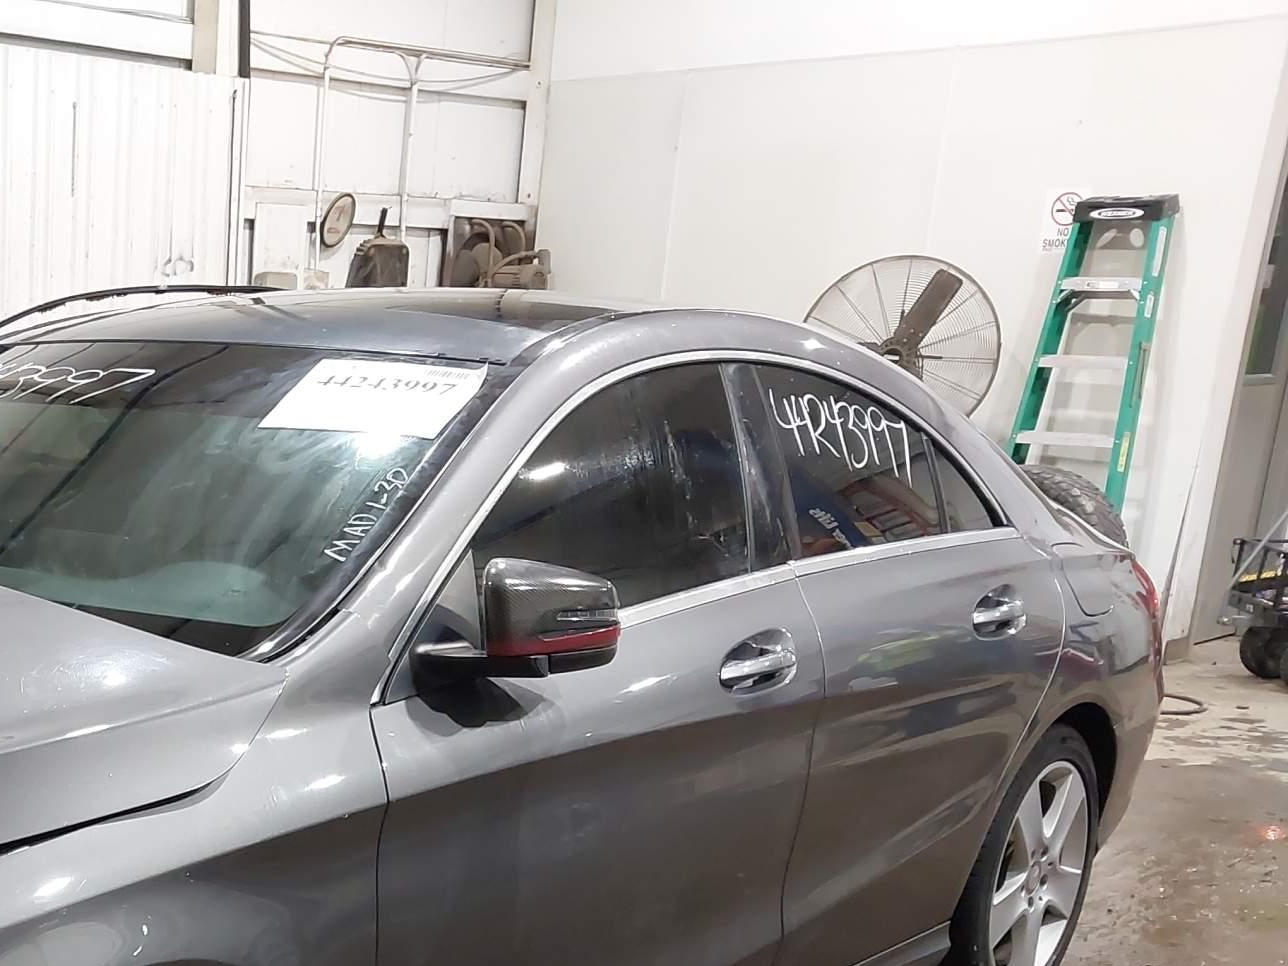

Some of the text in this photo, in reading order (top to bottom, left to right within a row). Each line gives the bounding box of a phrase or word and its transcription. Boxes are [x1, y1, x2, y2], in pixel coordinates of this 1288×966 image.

[1057, 227, 1069, 236] NO
[1042, 238, 1066, 248] SMOK
[317, 375, 459, 396] 44243997
[323, 513, 378, 562] MAD
